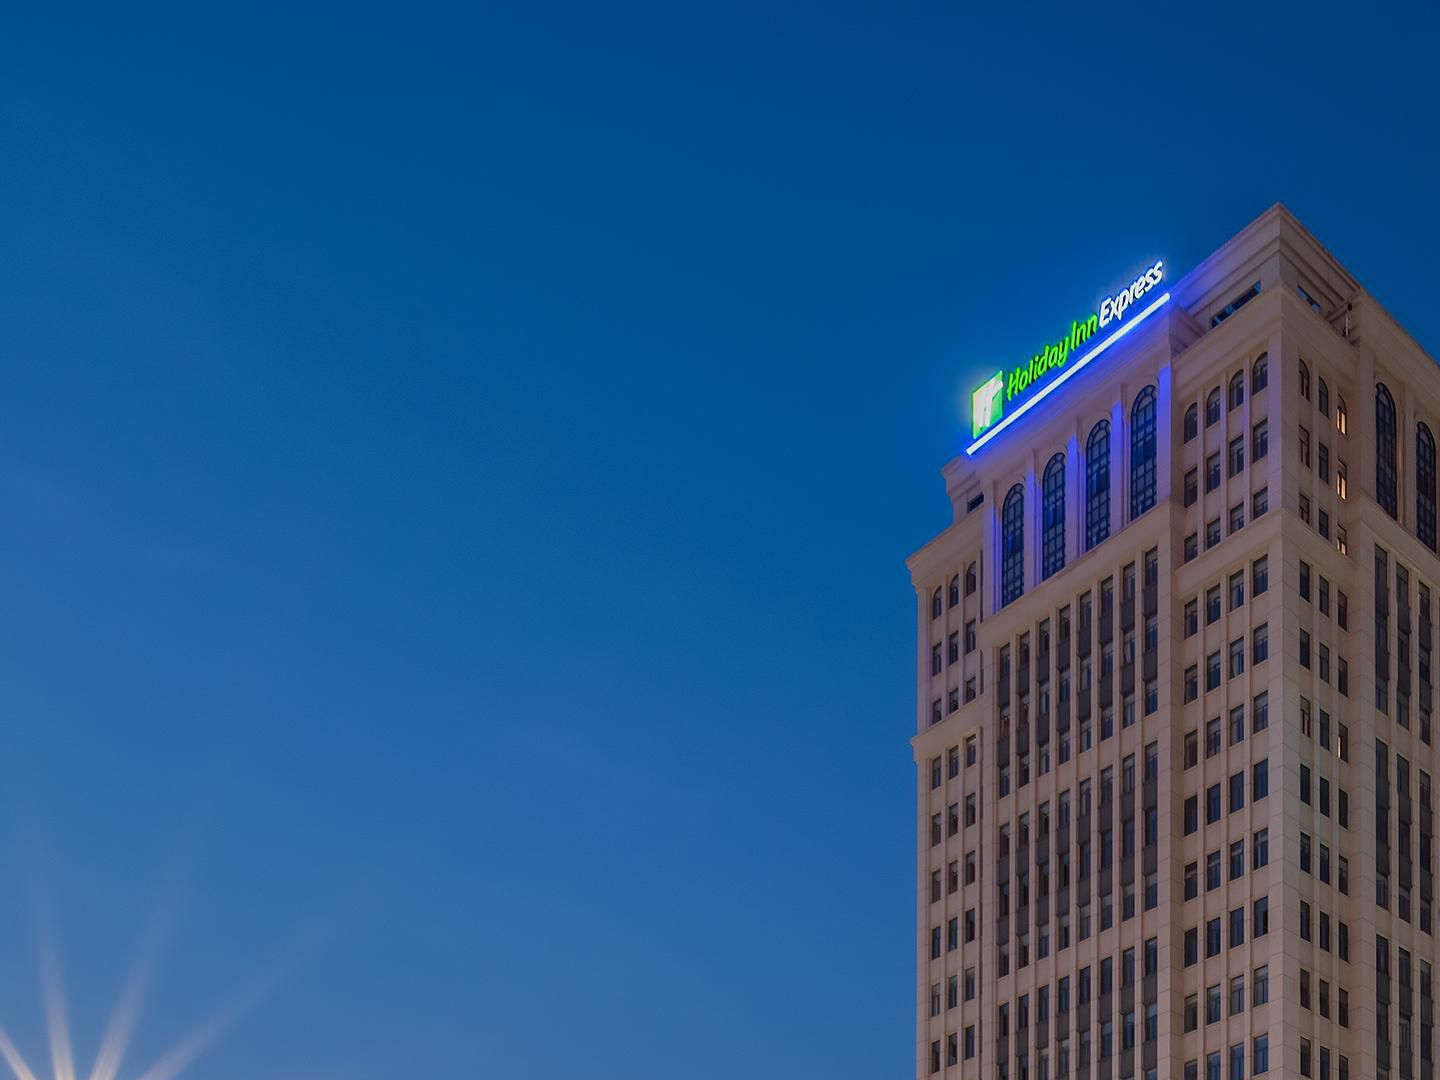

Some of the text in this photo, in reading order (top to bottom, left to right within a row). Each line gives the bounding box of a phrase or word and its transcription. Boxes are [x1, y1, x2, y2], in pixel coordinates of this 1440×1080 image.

[1006, 260, 1164, 401] Holiday Inn Express
